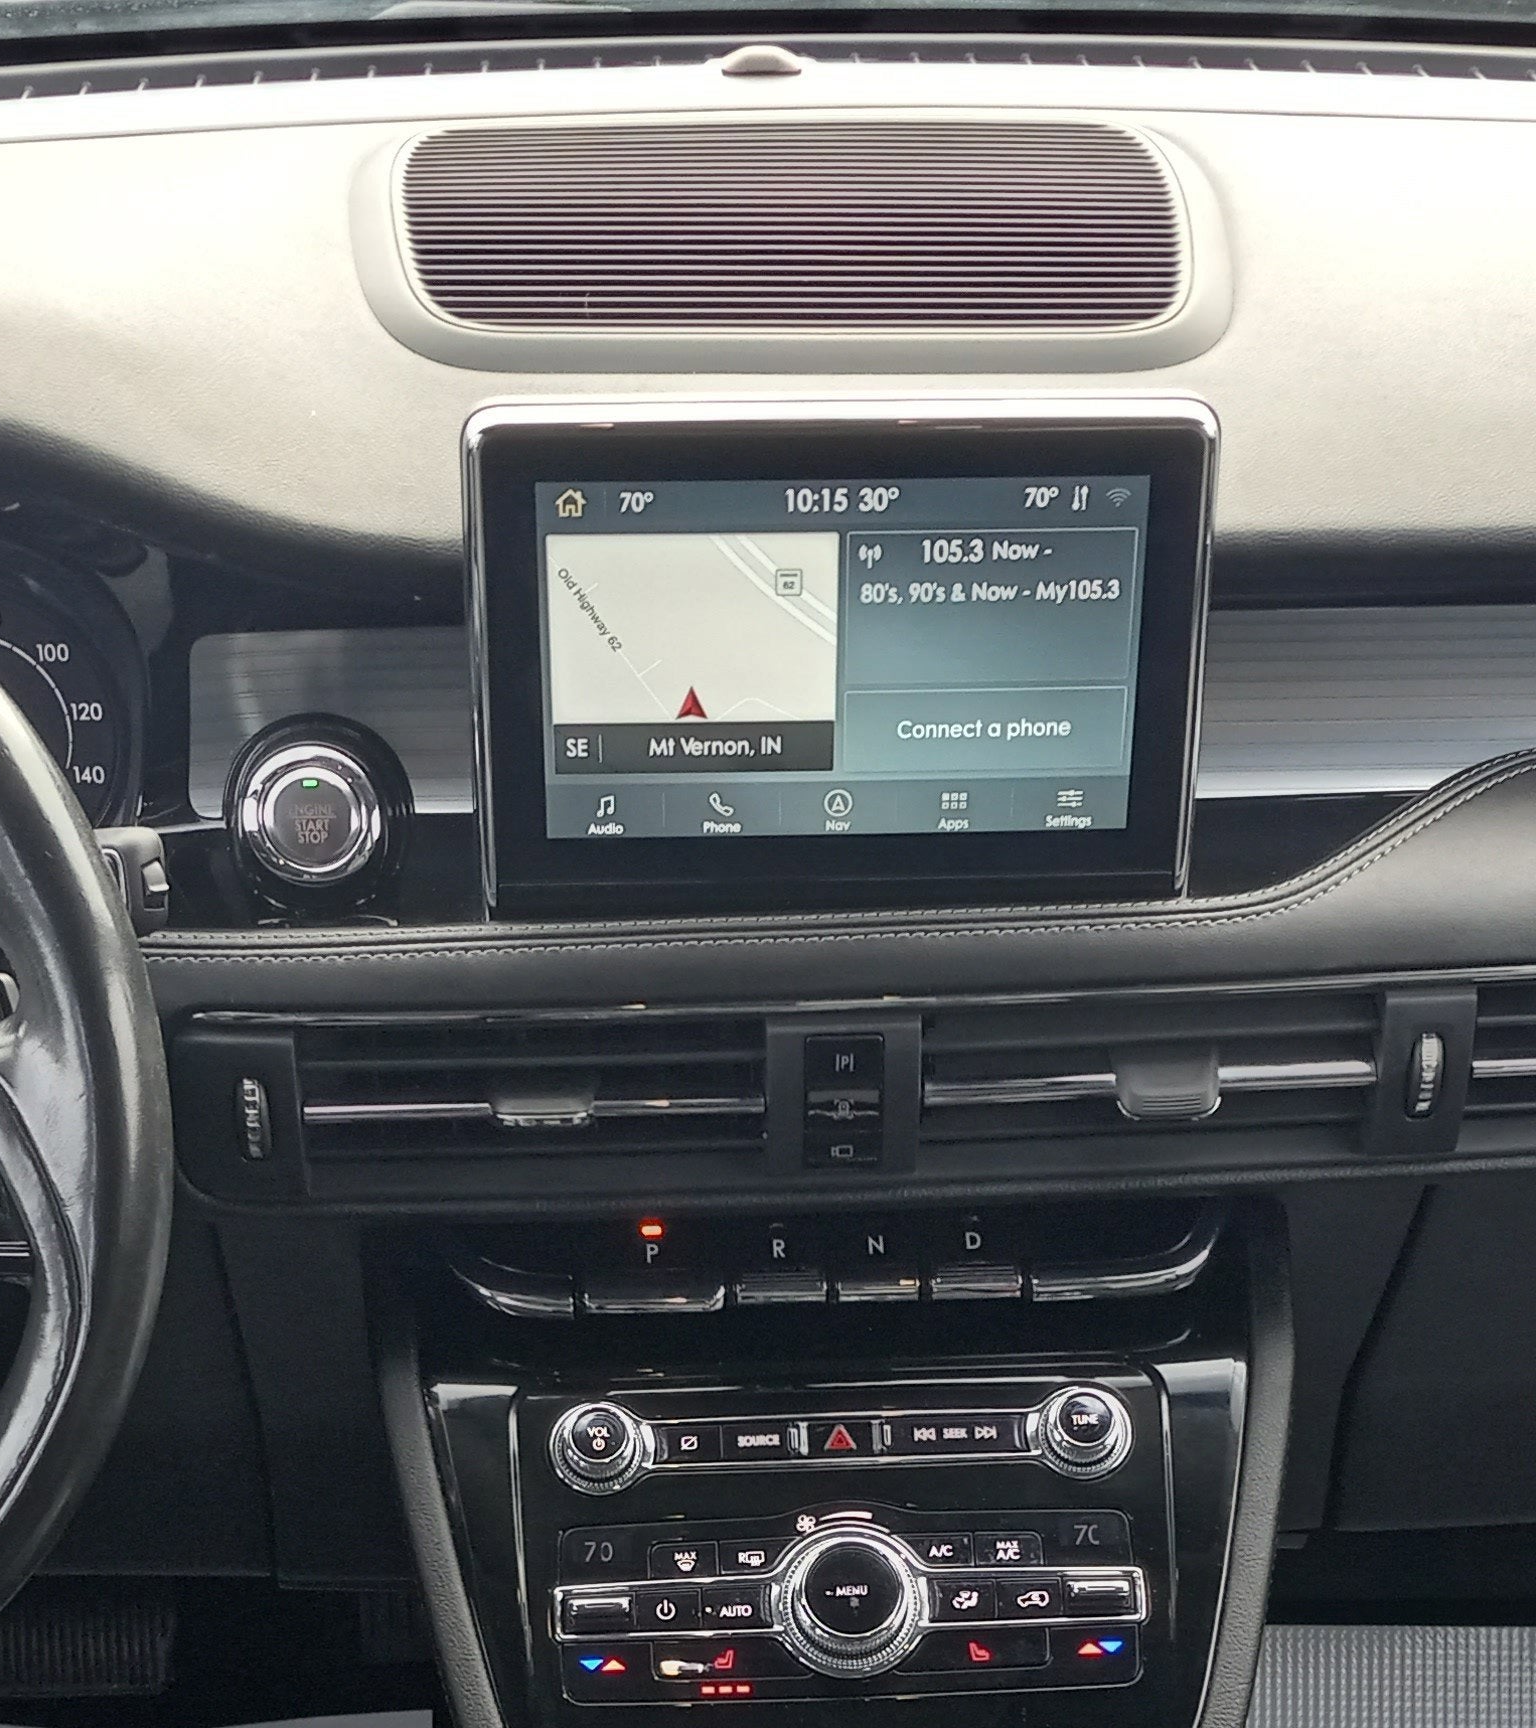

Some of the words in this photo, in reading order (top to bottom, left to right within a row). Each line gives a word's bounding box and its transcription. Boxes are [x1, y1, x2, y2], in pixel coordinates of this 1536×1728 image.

[619, 491, 654, 513] 70°
[784, 488, 849, 513] 10:15
[858, 487, 900, 512] 30°
[1024, 487, 1060, 509] 70°
[921, 539, 984, 564] 105.3
[992, 540, 1039, 561] Now
[908, 582, 946, 602] 90's
[971, 582, 1018, 601] Now
[1036, 579, 1120, 604] My105.3
[558, 568, 578, 591] Old
[573, 587, 611, 636] Highway
[607, 636, 622, 653] 62
[36, 643, 69, 662] 100
[71, 703, 103, 721] 120
[896, 719, 983, 739] Connect
[986, 723, 1001, 737] a
[1006, 718, 1072, 741] phone
[566, 738, 589, 758] SE
[648, 737, 675, 756] Mt
[680, 736, 755, 758] Vernon,
[761, 736, 782, 755] IN
[72, 765, 105, 784] 140
[295, 819, 330, 831] START
[588, 821, 624, 836] Audio
[703, 820, 741, 834] Phone
[825, 819, 851, 831] Nav
[937, 817, 969, 830] Apps
[1045, 814, 1092, 829] Settings
[298, 831, 328, 844] STOP
[645, 1244, 659, 1263] P
[773, 1239, 786, 1259] R
[868, 1236, 885, 1254] N
[966, 1232, 981, 1250] D
[1071, 1414, 1099, 1425] TUNE
[587, 1427, 610, 1438] VOL
[942, 1428, 967, 1440] SEEK
[737, 1434, 780, 1447] SOURCE
[584, 1542, 613, 1563] 70
[929, 1545, 953, 1558] A/C
[996, 1540, 1019, 1550] MAX
[674, 1551, 697, 1561] MAX
[996, 1549, 1021, 1560] A/C
[836, 1585, 868, 1596] MENU
[719, 1604, 753, 1617] AUTO
